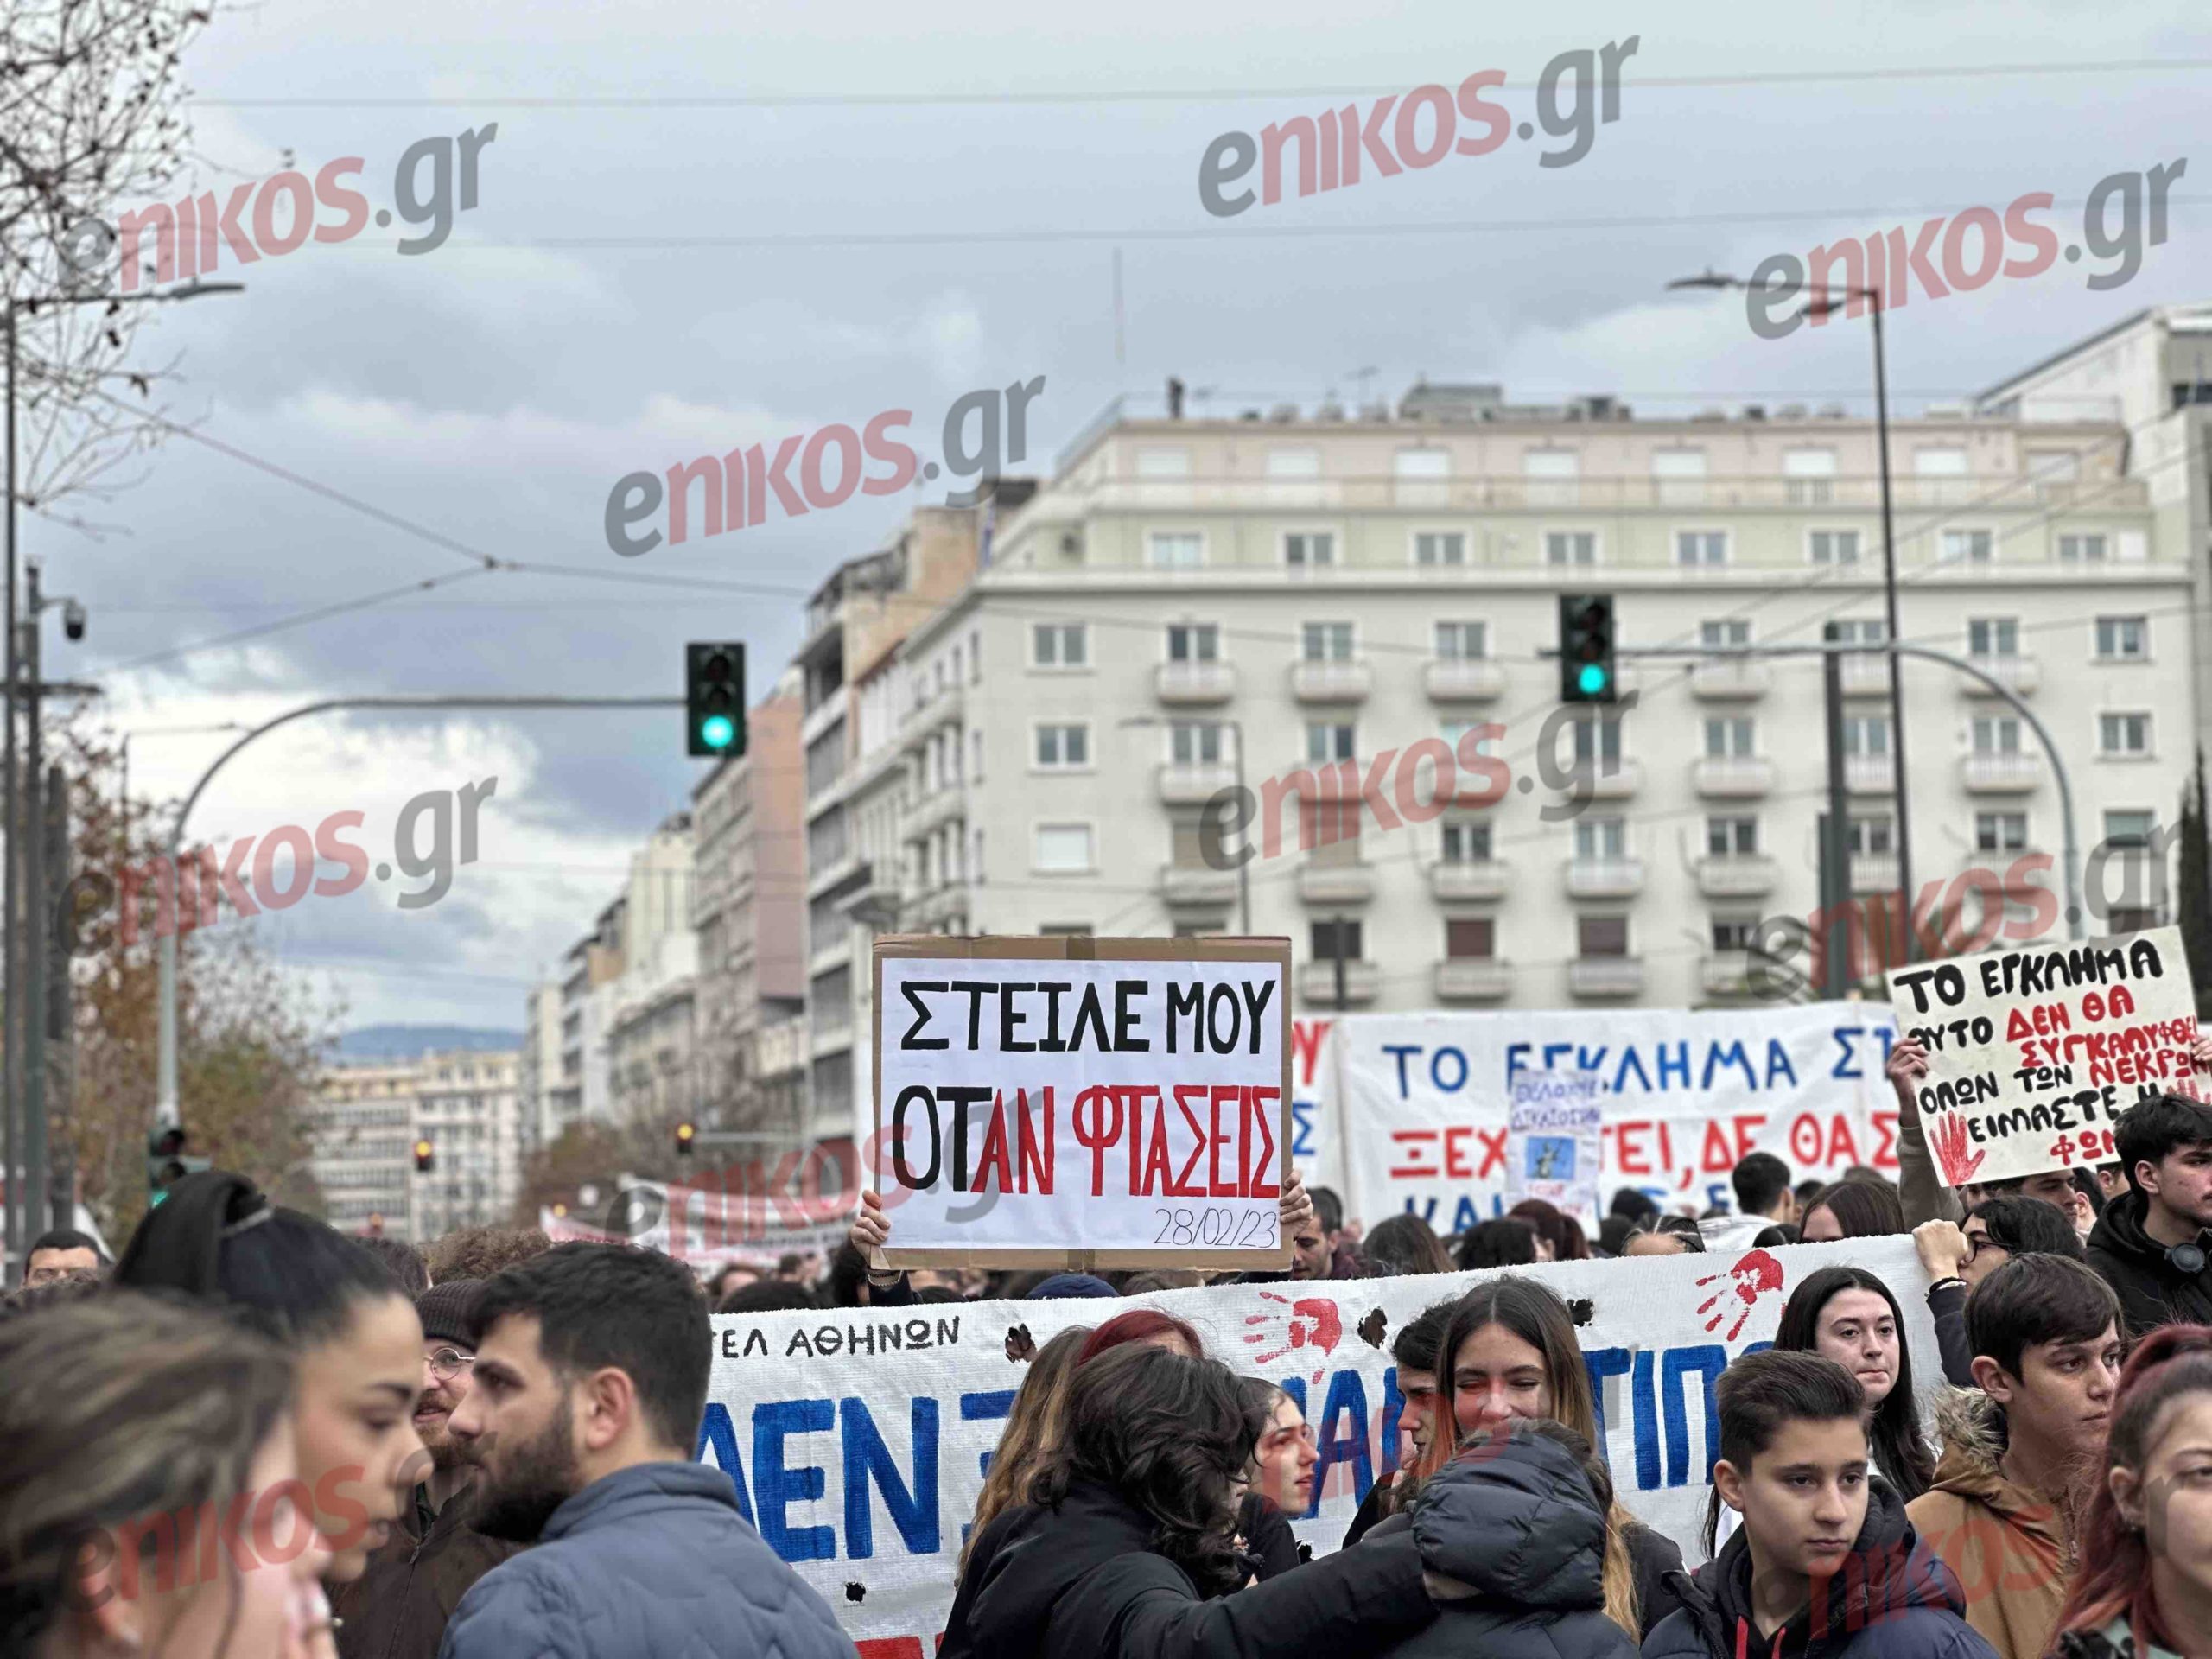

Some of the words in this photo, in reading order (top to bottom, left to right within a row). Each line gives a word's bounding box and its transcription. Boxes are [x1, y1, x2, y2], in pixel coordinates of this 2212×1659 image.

[1894, 964, 1965, 1013] ΤΟ
[1980, 939, 2163, 997] ΕΓΚΛΗΜΑ
[901, 981, 1150, 1052] ΣΤΕΙΛΕ
[1166, 980, 1275, 1054] ΜΟΥ
[1908, 1016, 1993, 1052] ΑΥΤΟ
[2006, 1002, 2071, 1042] ΔΕΝ
[2082, 984, 2135, 1021] ΘΑ
[1381, 1046, 1469, 1099] ΤΟ
[1919, 1071, 1999, 1115] ΟΛΩΝ
[2012, 1064, 2073, 1093] ΤΩΝ
[893, 1085, 1055, 1195] ΟΤΑΝ
[1072, 1085, 1280, 1198] ΦΤΑΣΕΙΣ
[1789, 1111, 1860, 1168] ΘΑ
[1967, 1085, 2121, 1143] ΕΙΜΑΣΤΕ
[1154, 1206, 1277, 1248] 28/02/23
[711, 1328, 768, 1358] ΕΛ
[785, 1315, 961, 1358] ΑΘΗΝΩΝ
